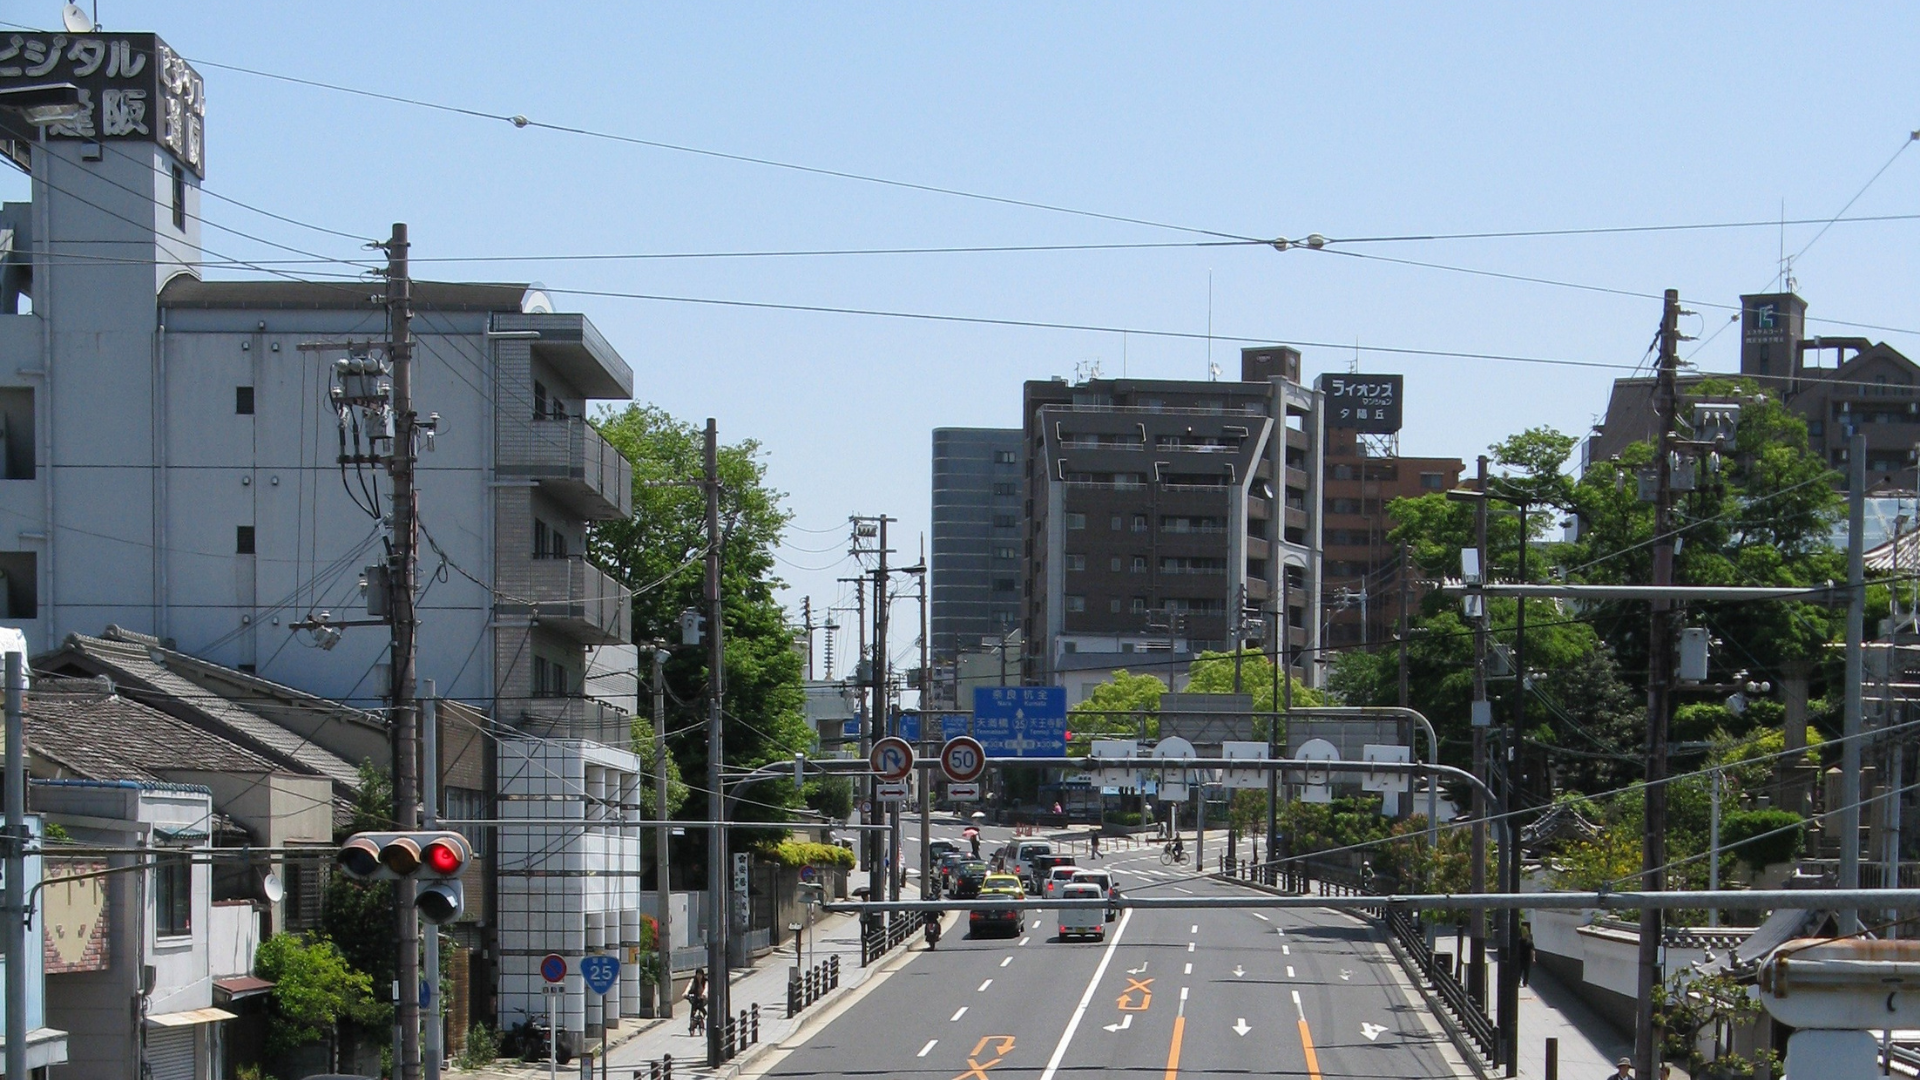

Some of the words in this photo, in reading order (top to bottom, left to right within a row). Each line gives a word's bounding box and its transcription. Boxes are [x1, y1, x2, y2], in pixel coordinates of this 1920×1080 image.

[1332, 380, 1393, 397] ライオンズ
[1340, 408, 1384, 420] 夕陽丘
[992, 690, 1016, 700] 奈良
[1024, 690, 1048, 700] 杭全
[1014, 721, 1025, 729] 25
[952, 751, 974, 768] 50
[590, 965, 613, 980] 25
